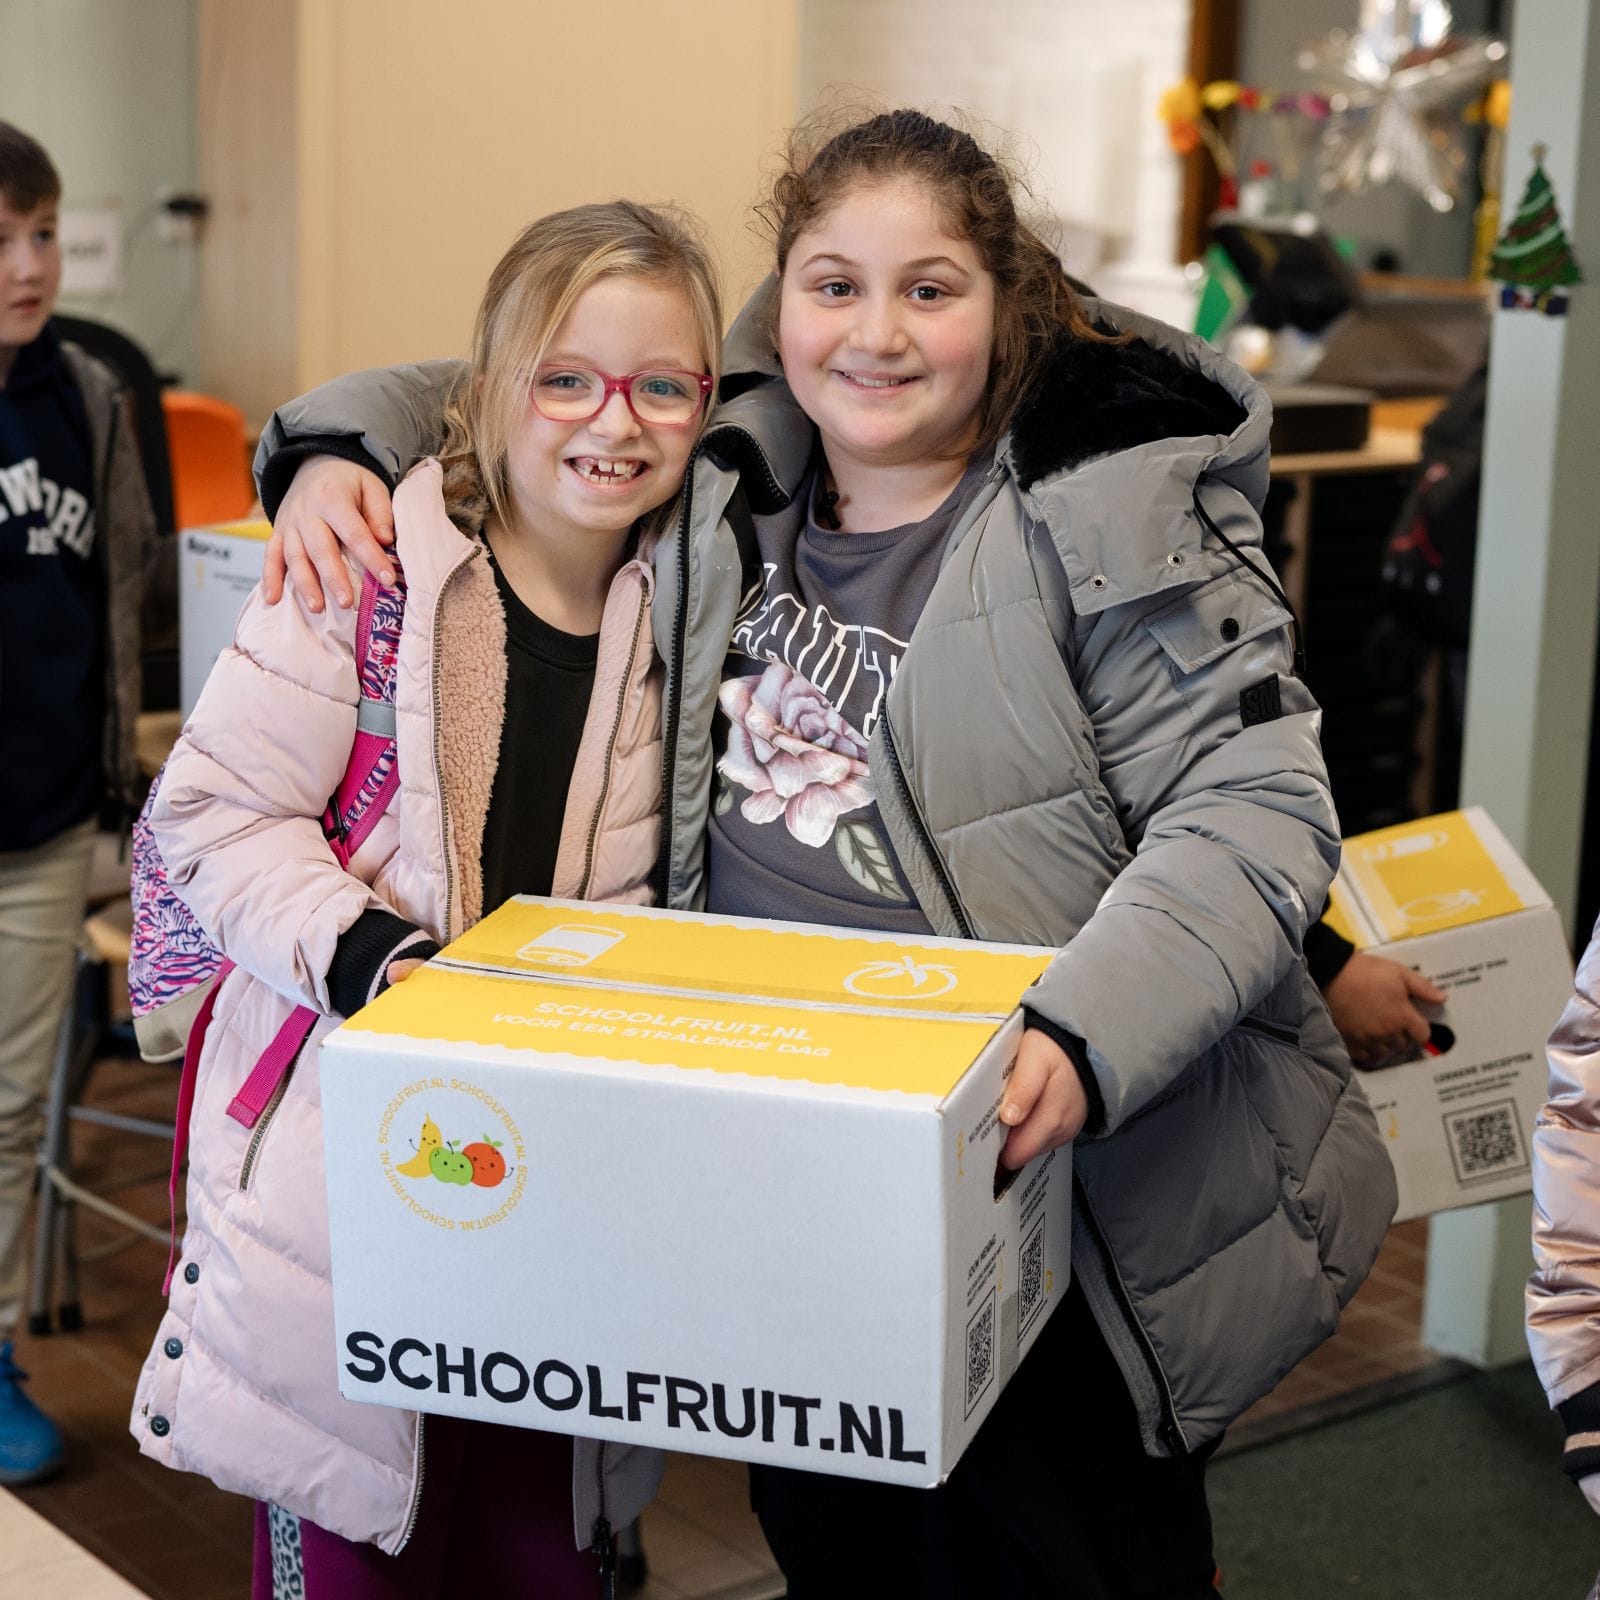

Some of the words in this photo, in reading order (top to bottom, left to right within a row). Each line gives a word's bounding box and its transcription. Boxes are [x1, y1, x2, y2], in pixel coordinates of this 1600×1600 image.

[492, 1013, 563, 1030] VOOR
[567, 1021, 617, 1036] EEN
[620, 1026, 771, 1052] STRALENDE
[775, 1042, 833, 1058] DAG
[534, 1001, 813, 1041] SCHOOLFRUIT.NL
[378, 1077, 448, 1145] SCHOOLFRUIT.NL
[450, 1078, 527, 1160] SCHOOLFRUIT.NL
[379, 1150, 456, 1231] SCHOOLFRUIT.NL
[458, 1165, 528, 1232] SCHOOLFRUIT.NL
[344, 1330, 928, 1466] SCHOOLFRUIT.NL
